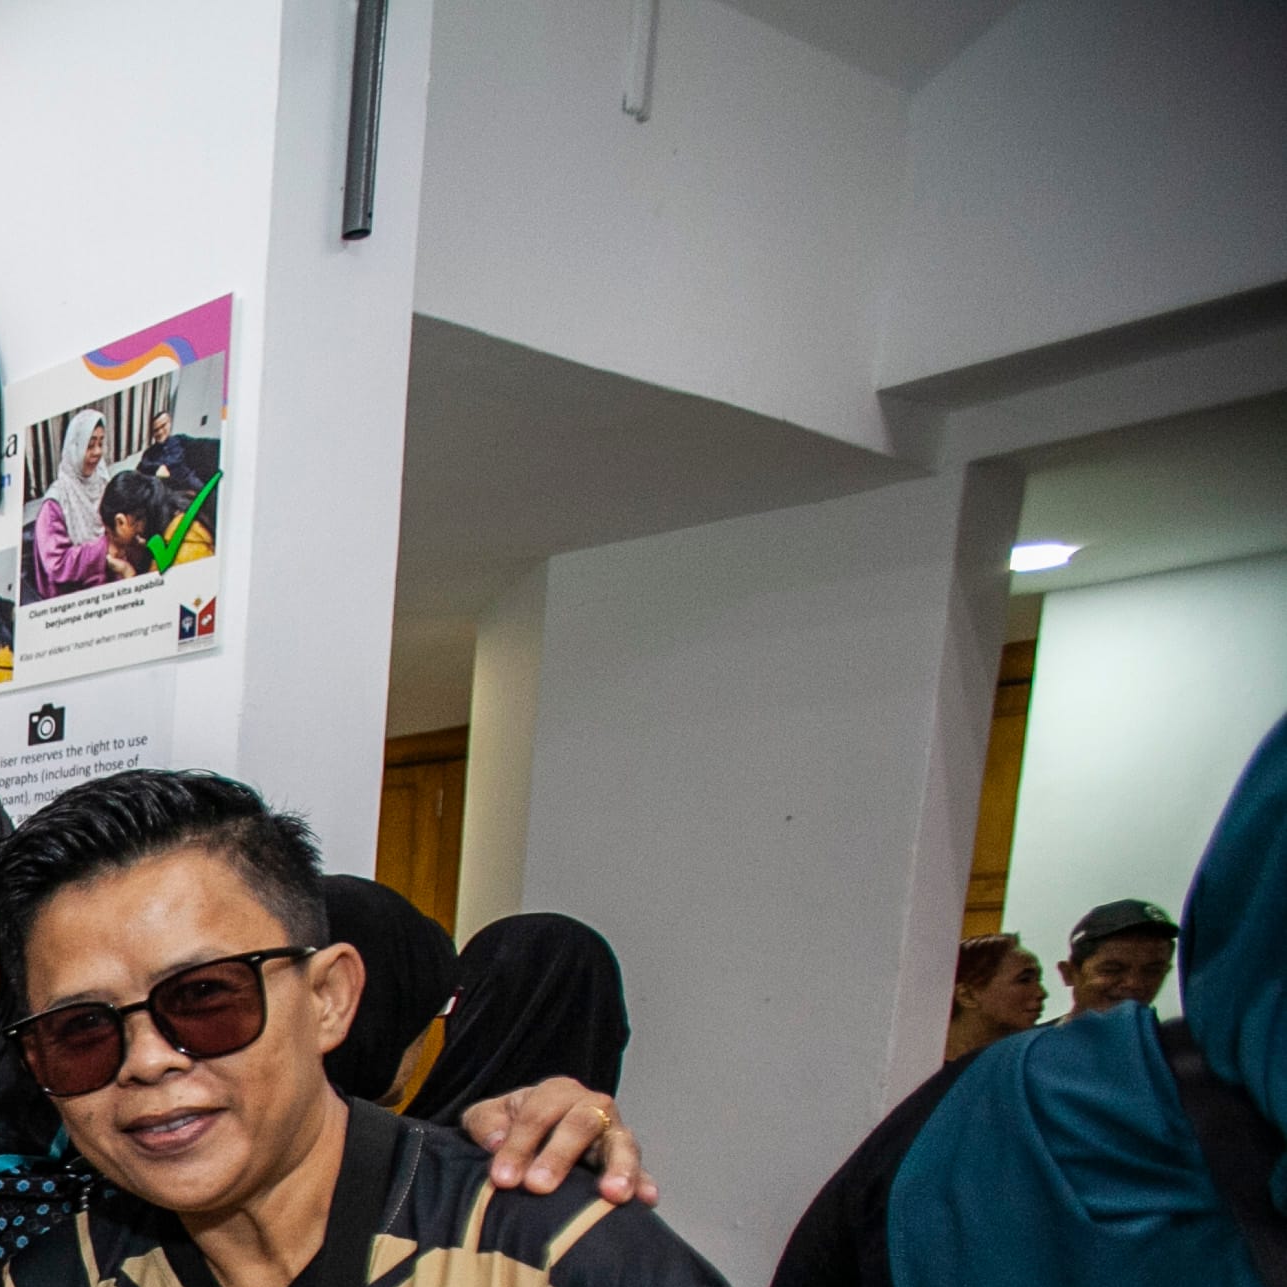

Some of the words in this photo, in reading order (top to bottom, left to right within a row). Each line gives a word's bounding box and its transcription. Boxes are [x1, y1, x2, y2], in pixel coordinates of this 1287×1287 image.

[49, 601, 76, 617] tangan
[77, 594, 100, 609] orang
[101, 590, 116, 602] tua
[117, 585, 132, 597] kita
[134, 577, 165, 596] apabila
[44, 612, 82, 630] berjumpa
[83, 605, 114, 622] dengan
[114, 597, 146, 613] mereka
[34, 649, 48, 659] our
[73, 638, 94, 651] hand
[95, 633, 116, 647] when
[117, 627, 149, 644] meeting
[151, 620, 174, 634] them
[20, 749, 64, 765] reserves
[66, 743, 84, 758] the
[85, 739, 111, 757] right
[113, 738, 126, 750] to
[127, 734, 149, 747] use
[41, 763, 92, 784] (including
[93, 757, 125, 774] those
[127, 754, 140, 768] of
[3, 792, 32, 807] pant),
